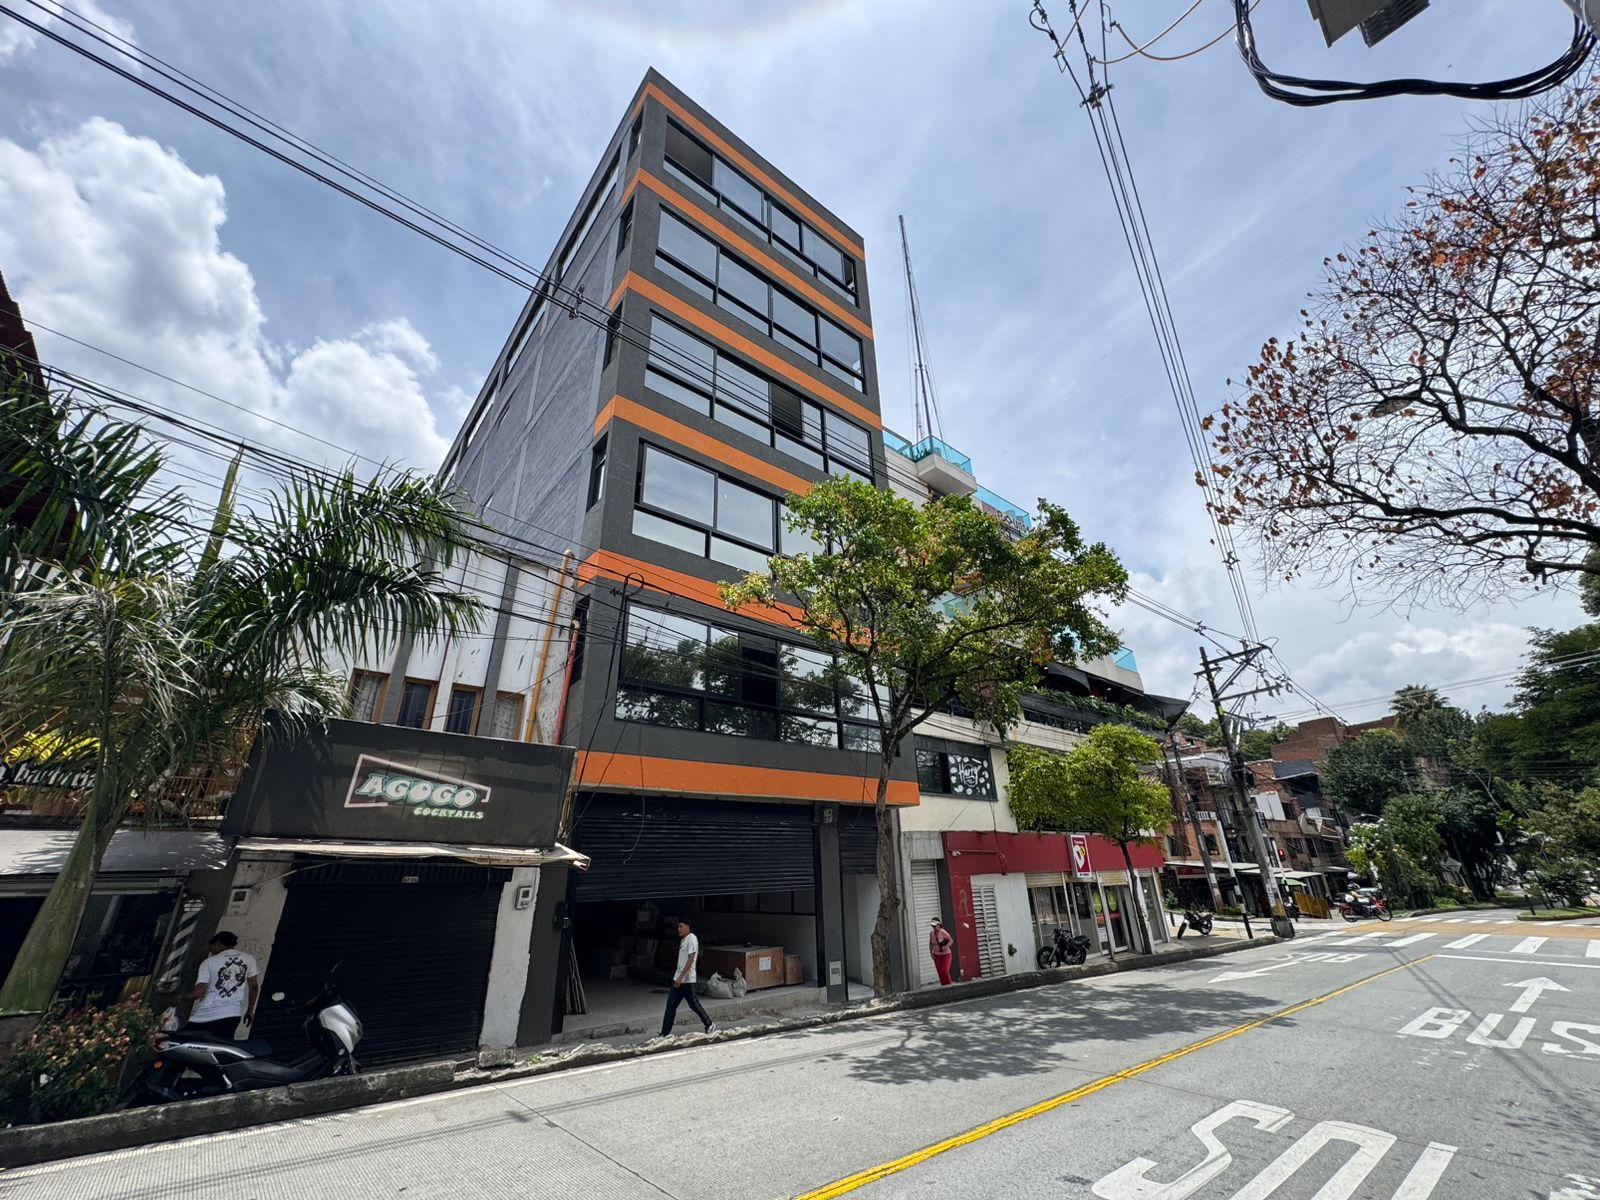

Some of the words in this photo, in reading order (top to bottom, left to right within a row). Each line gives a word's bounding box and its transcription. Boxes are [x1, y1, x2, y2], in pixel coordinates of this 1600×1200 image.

[354, 772, 477, 809] AGOGO
[413, 806, 484, 820] COCKTAILS
[1396, 1006, 1600, 1061] BUS
